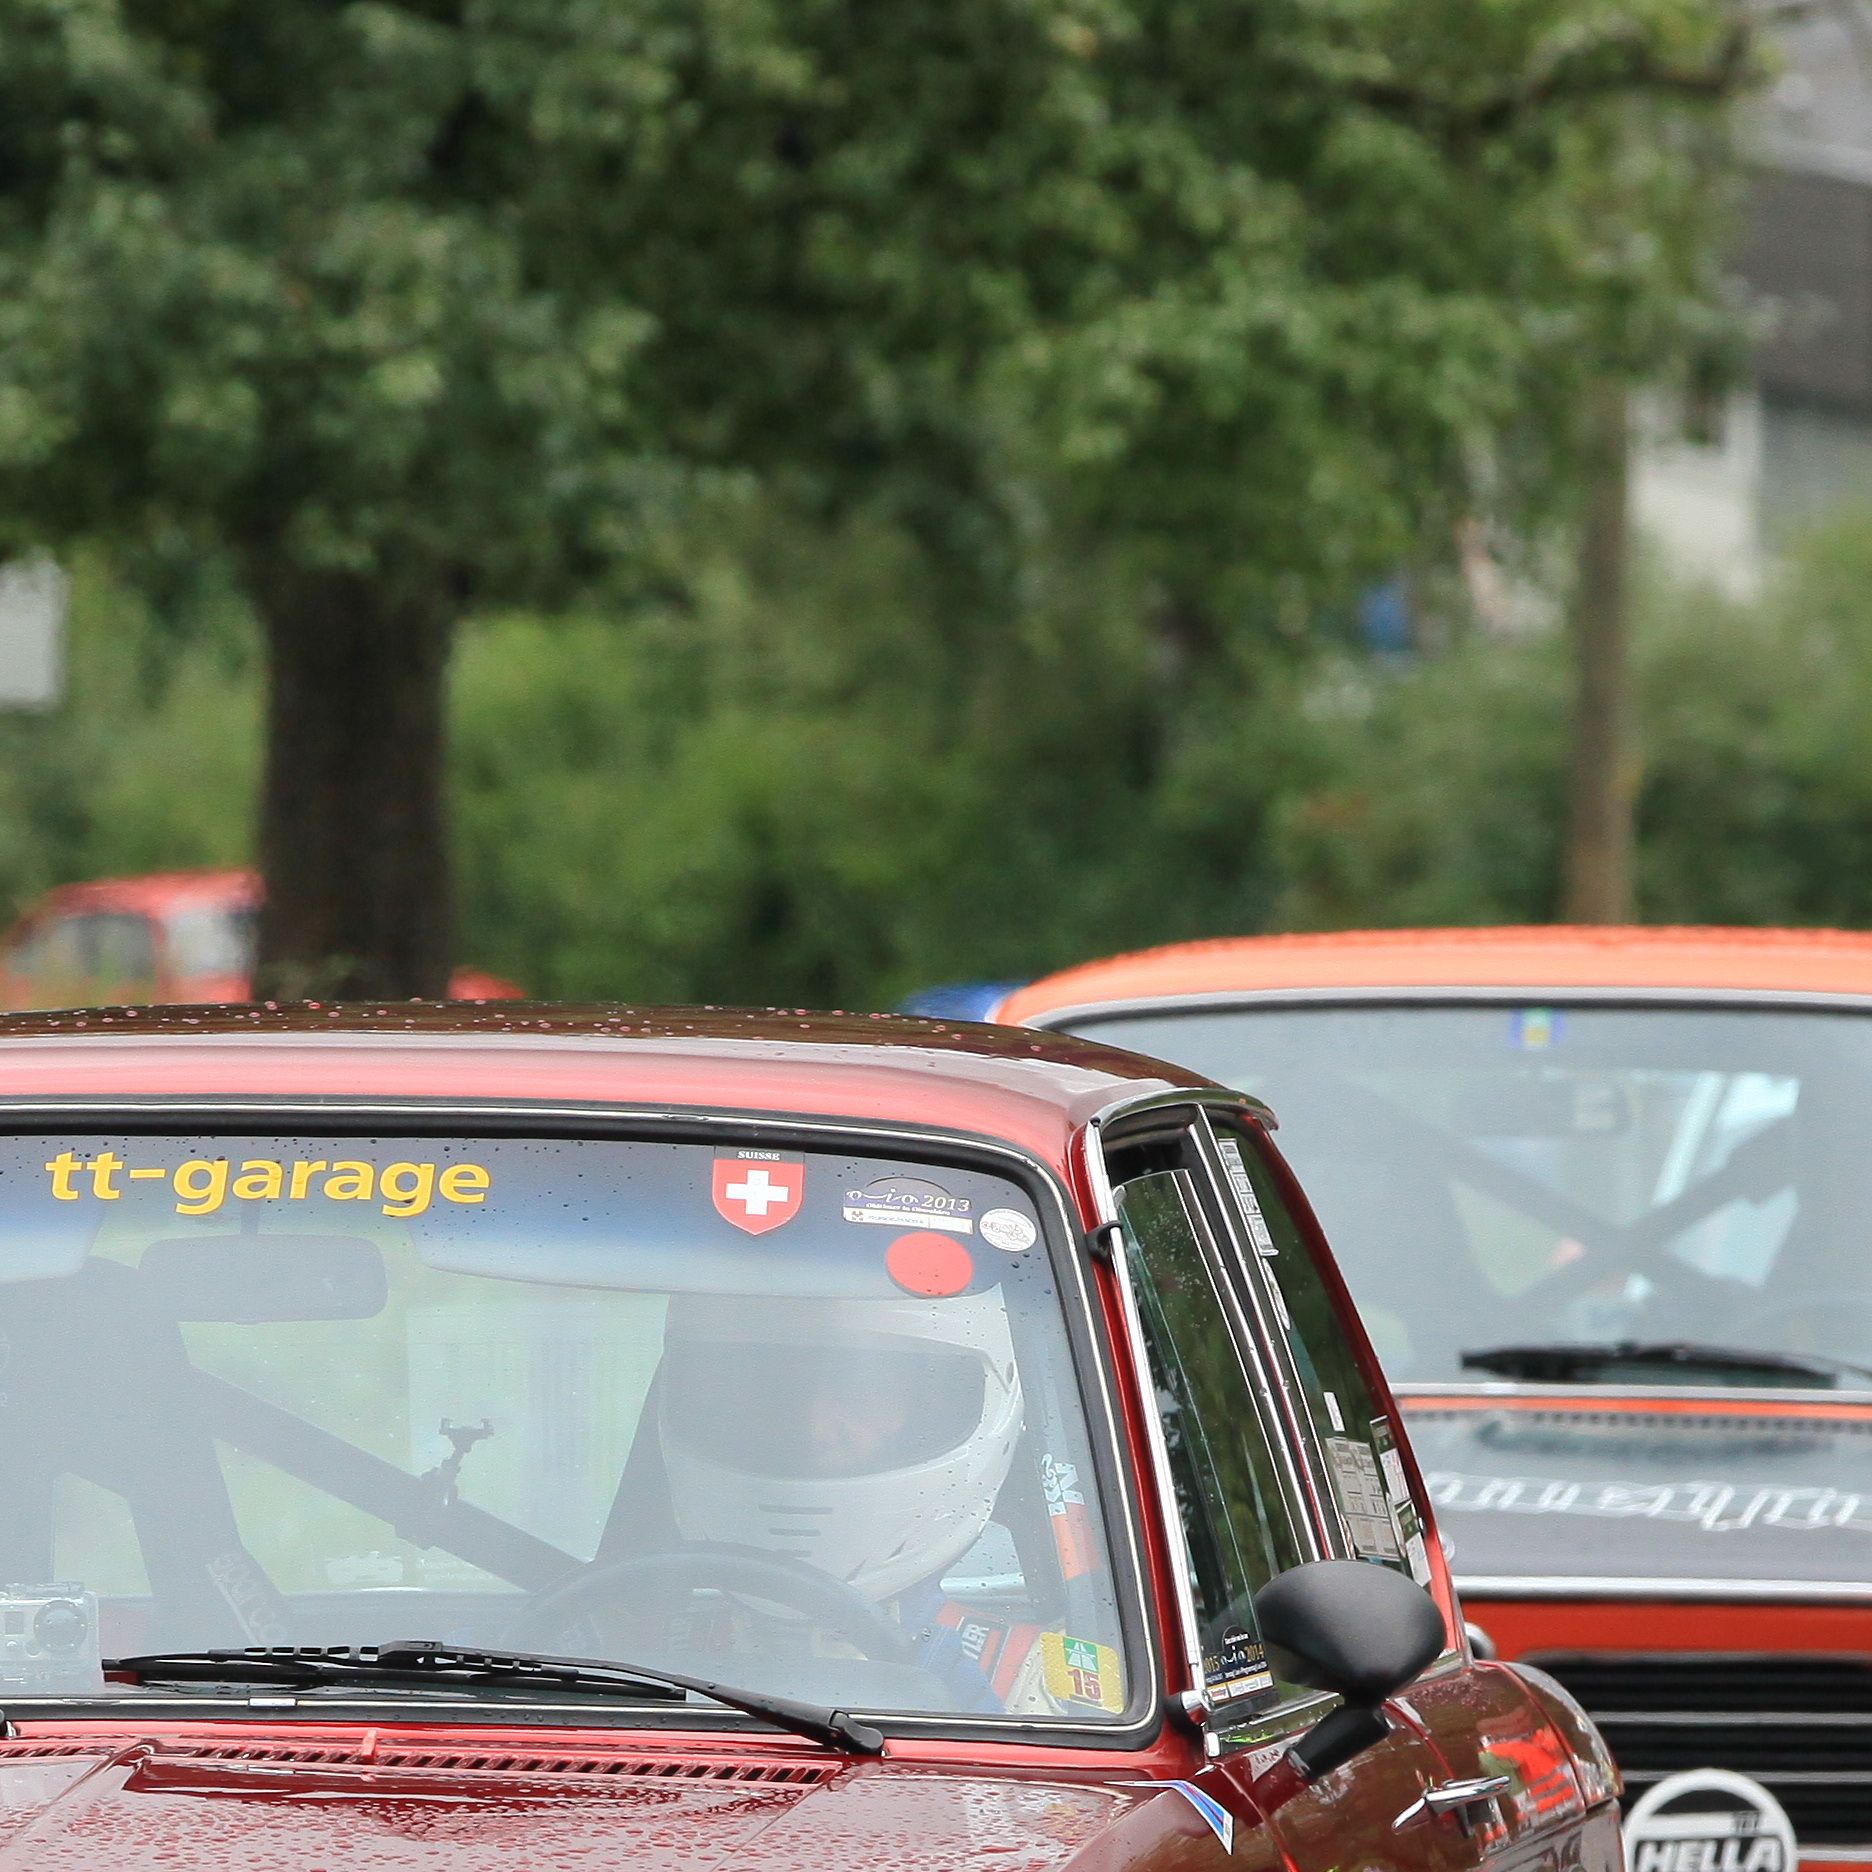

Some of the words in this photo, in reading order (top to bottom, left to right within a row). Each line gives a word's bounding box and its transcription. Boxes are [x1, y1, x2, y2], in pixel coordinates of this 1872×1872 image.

[737, 1150, 780, 1161] SUISSE
[45, 1151, 491, 1217] tt-garage
[921, 1194, 970, 1212] 2013
[1067, 1668, 1102, 1700] 15
